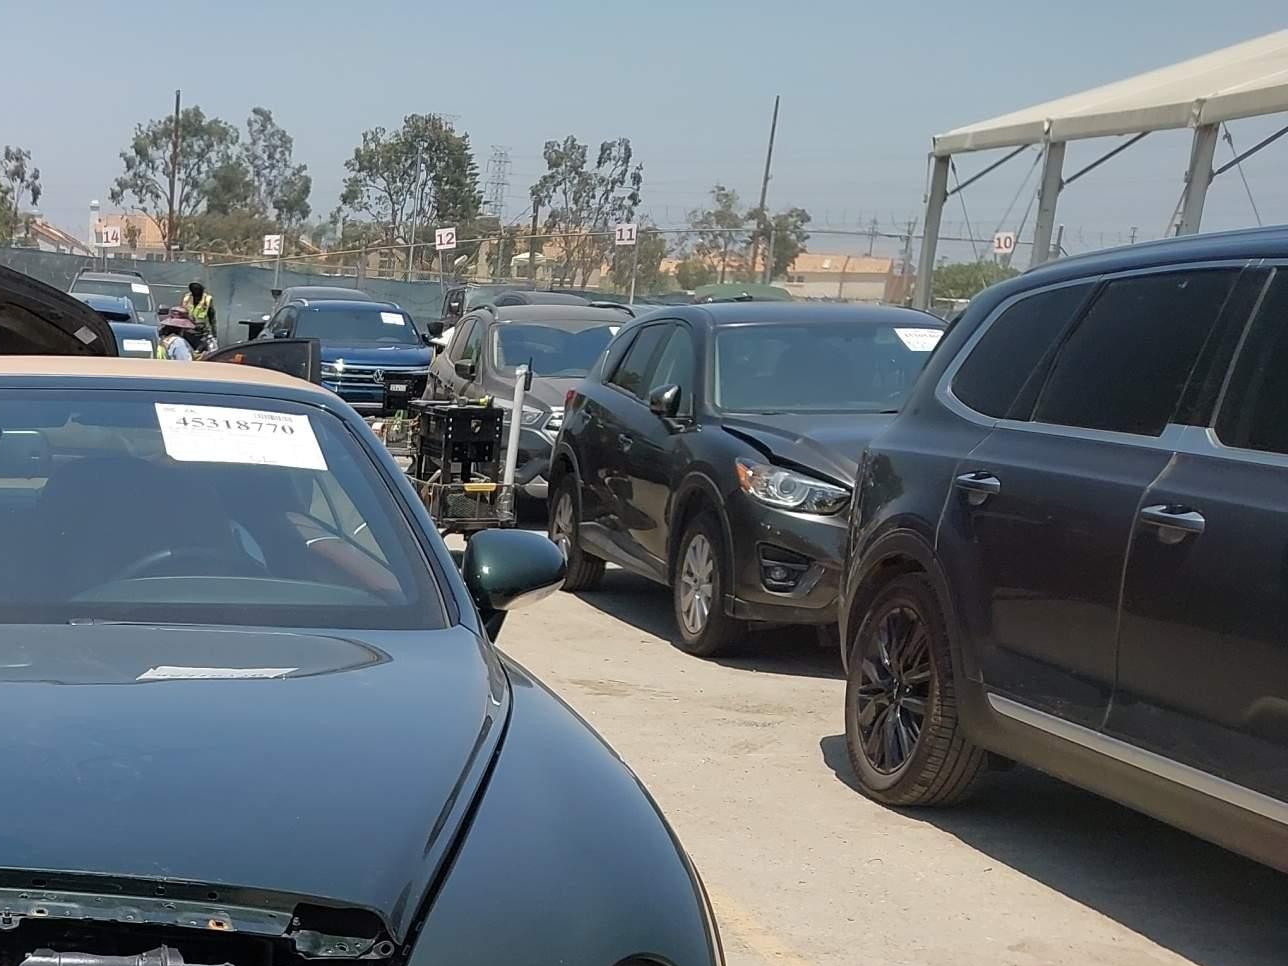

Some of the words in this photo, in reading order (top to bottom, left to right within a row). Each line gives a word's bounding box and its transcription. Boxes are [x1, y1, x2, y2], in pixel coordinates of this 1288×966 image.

[103, 229, 120, 243] 14
[437, 231, 455, 246] 12
[616, 227, 635, 241] 11
[995, 235, 1012, 249] 10
[175, 416, 295, 435] 45318770
